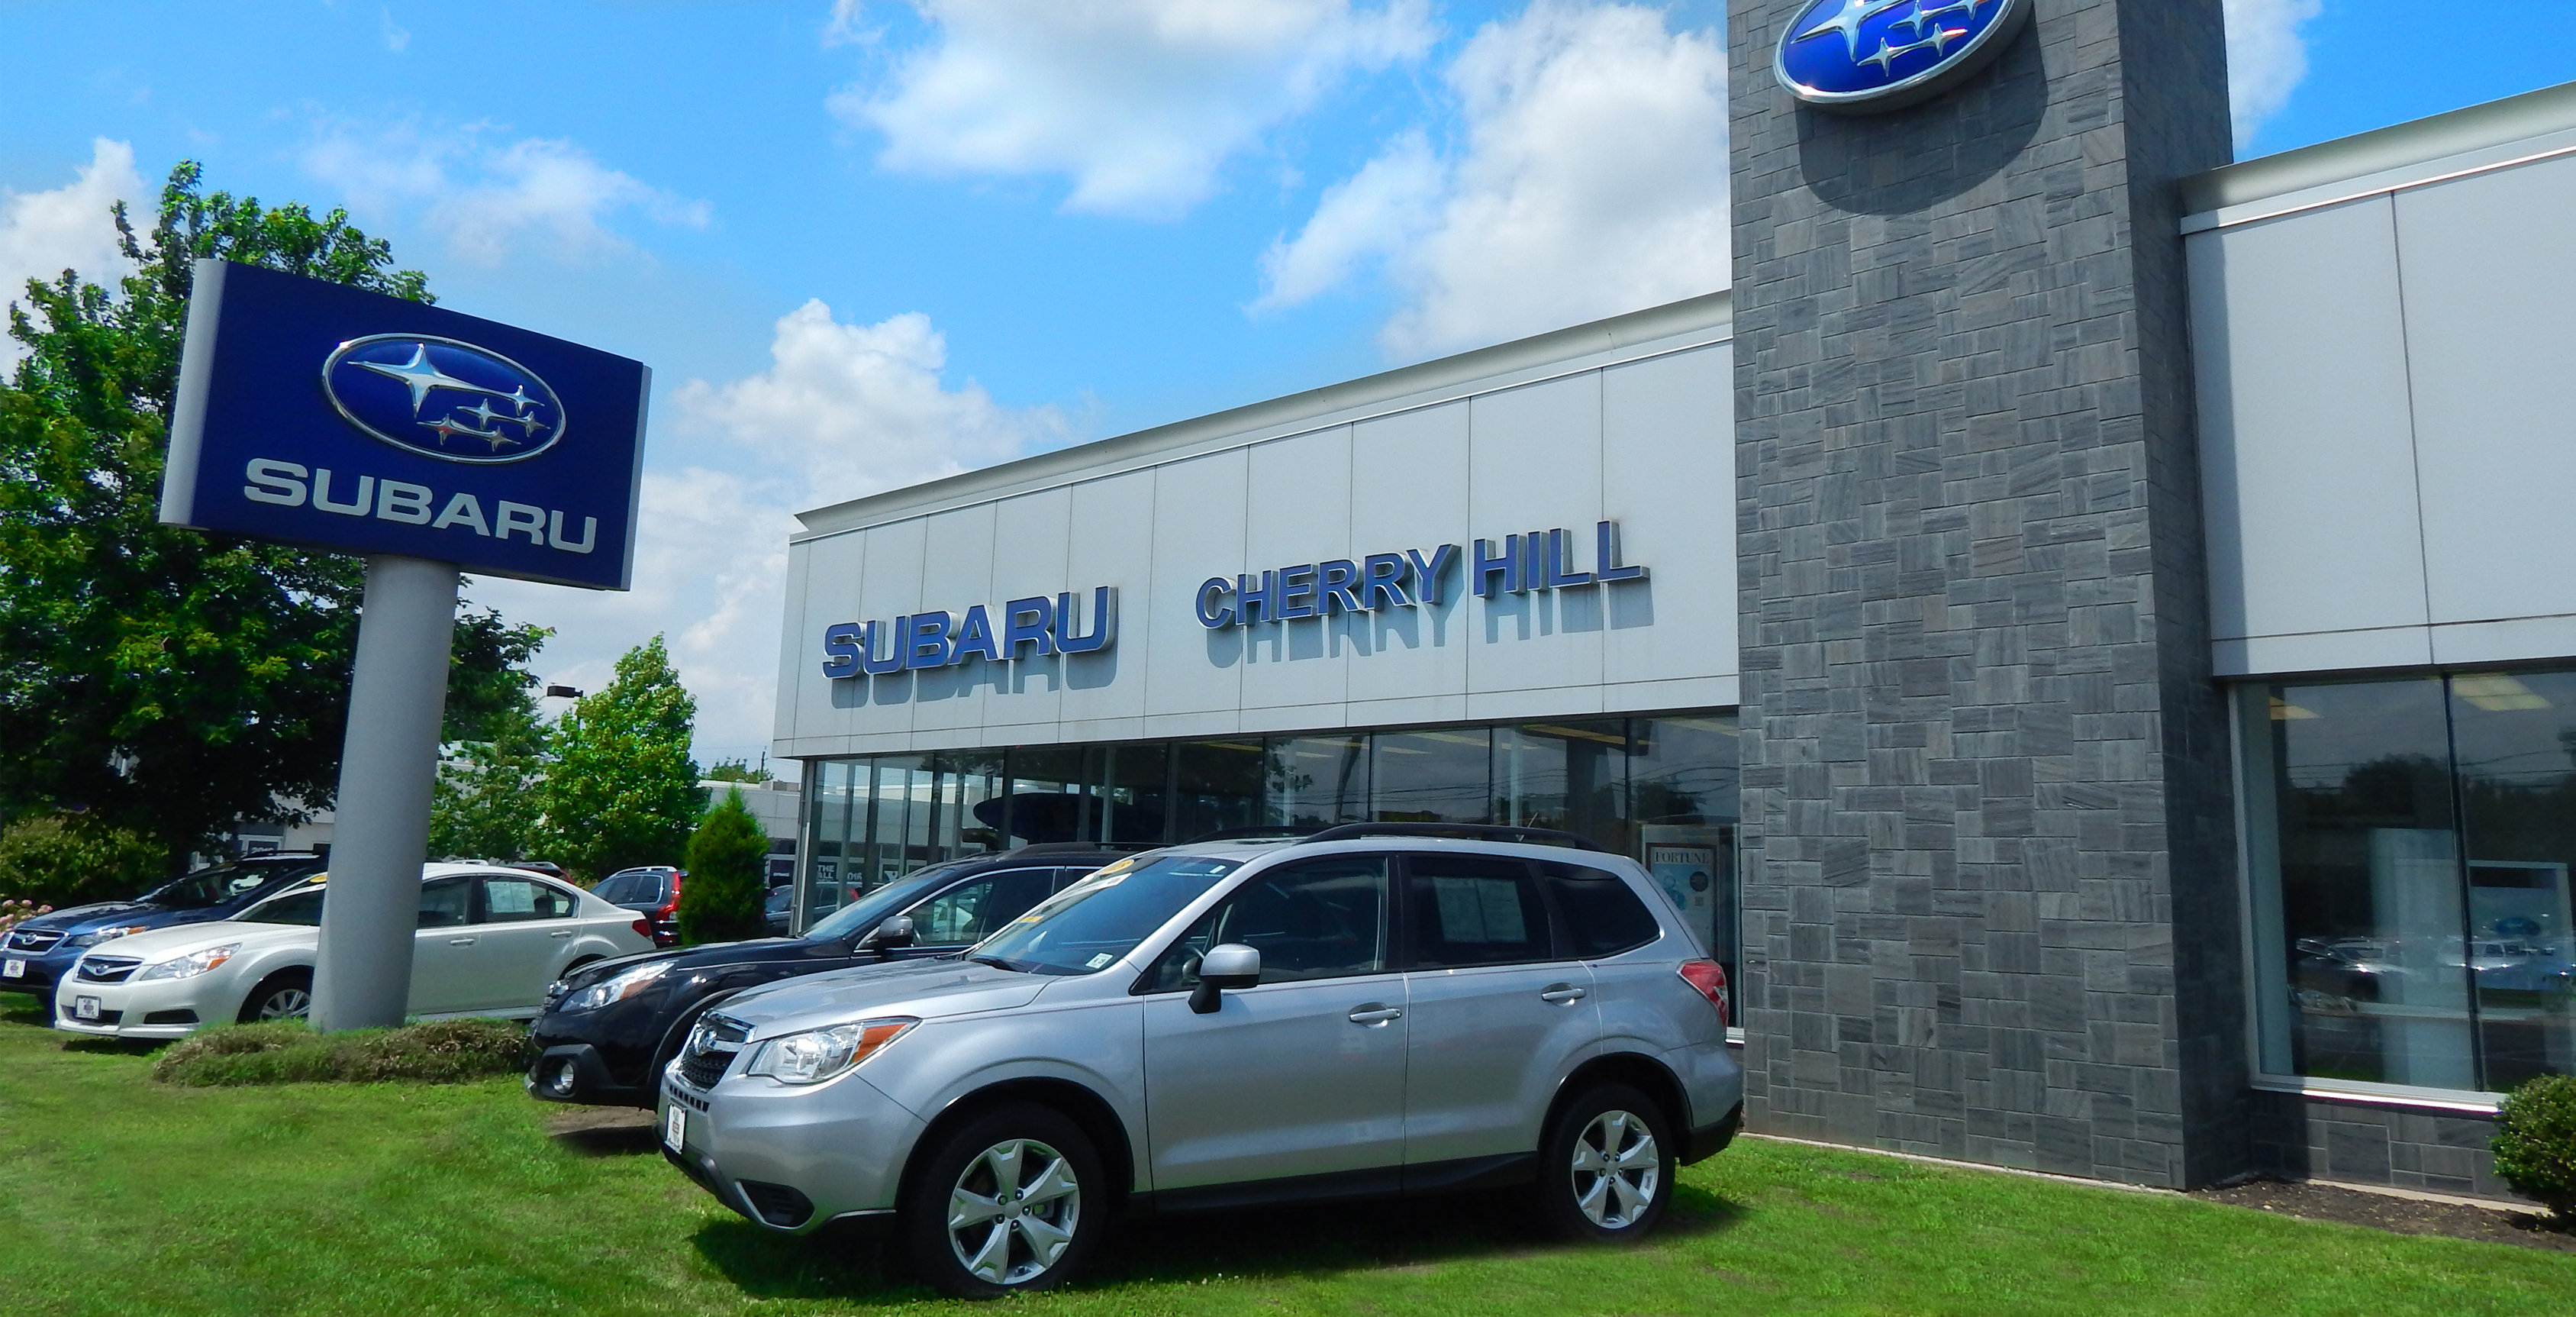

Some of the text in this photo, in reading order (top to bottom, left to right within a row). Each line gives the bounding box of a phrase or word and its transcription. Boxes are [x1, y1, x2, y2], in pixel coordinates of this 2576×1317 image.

[243, 458, 597, 554] SUBARU
[822, 520, 1649, 678] SUBARU CHERRY HILL
[817, 864, 835, 873] THE
[1656, 851, 1709, 863] FORTUNE
